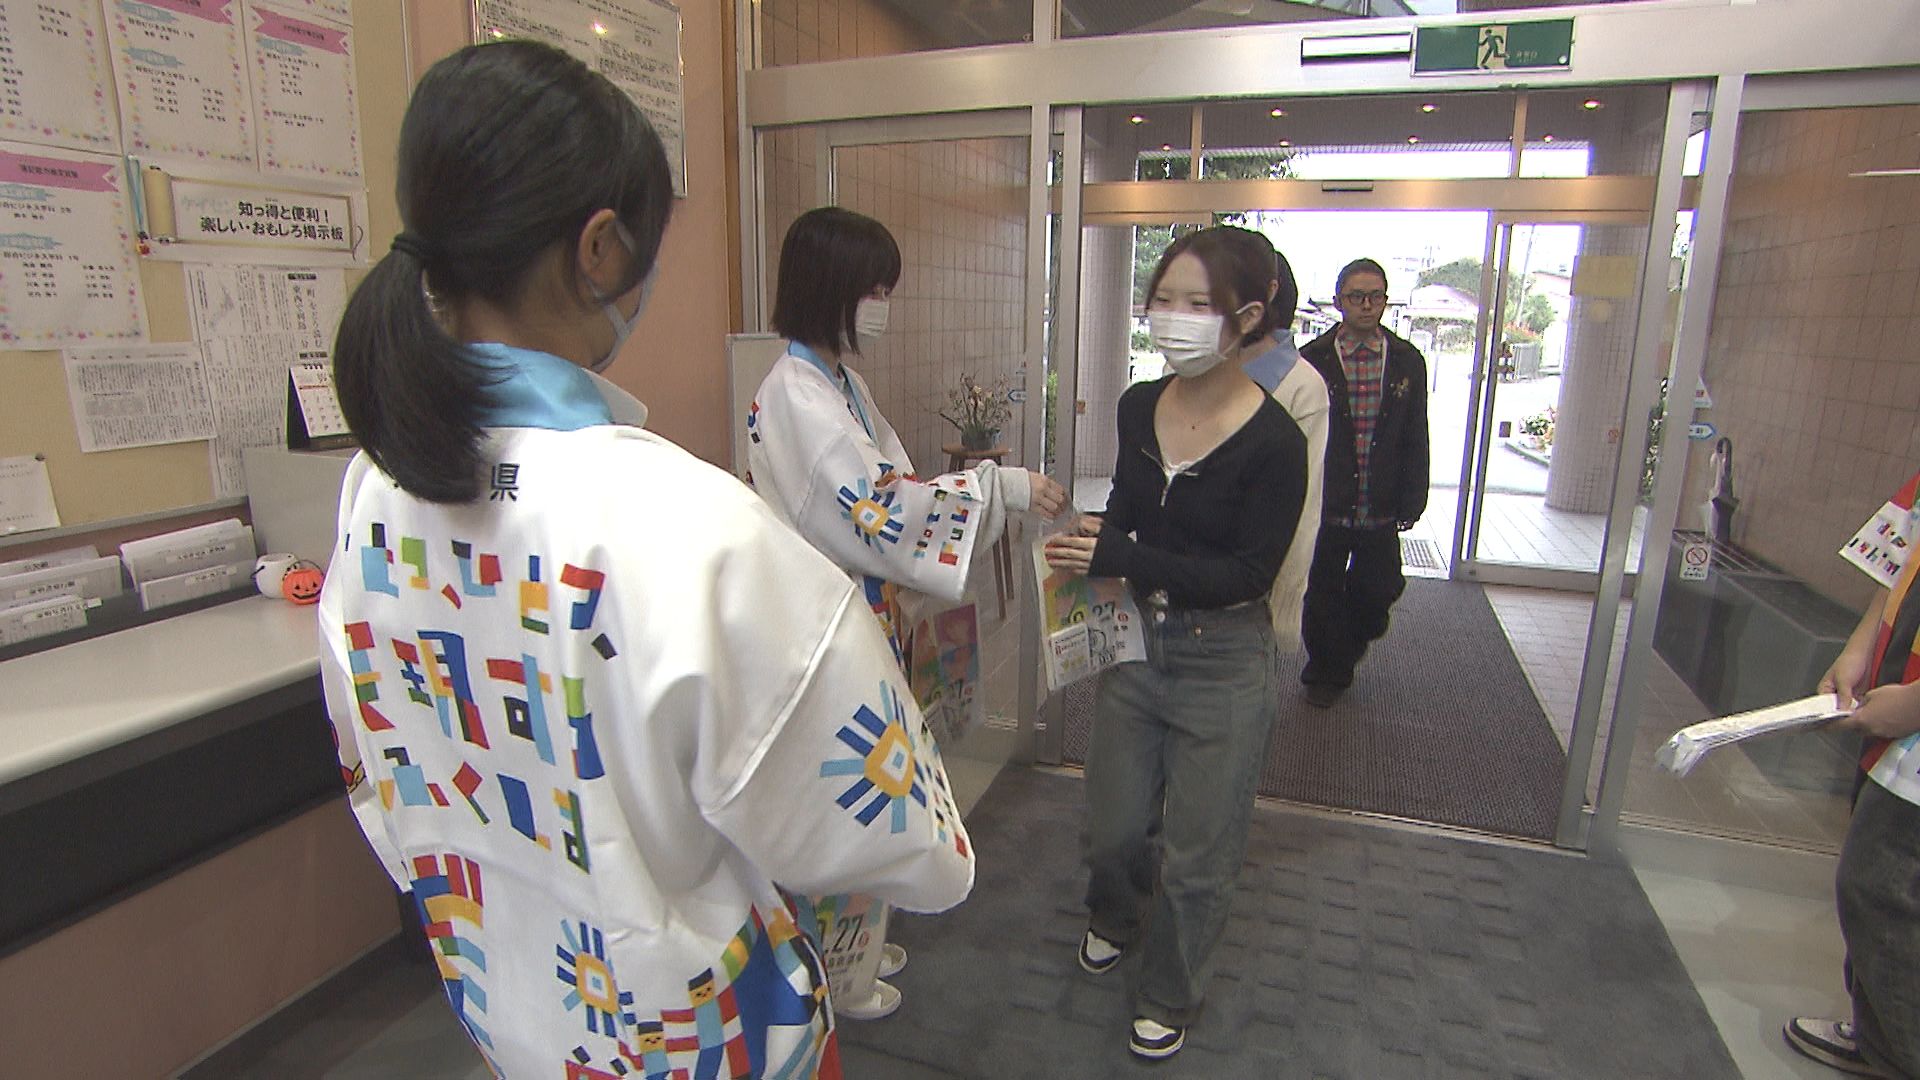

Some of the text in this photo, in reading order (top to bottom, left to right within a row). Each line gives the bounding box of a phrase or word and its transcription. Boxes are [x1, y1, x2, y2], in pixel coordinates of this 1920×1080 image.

[238, 201, 329, 224] 知っ得と便利！
[200, 216, 344, 241] 楽しい・おもしろ掲示板
[489, 463, 520, 501] 県
[378, 746, 591, 875] ふくしま
